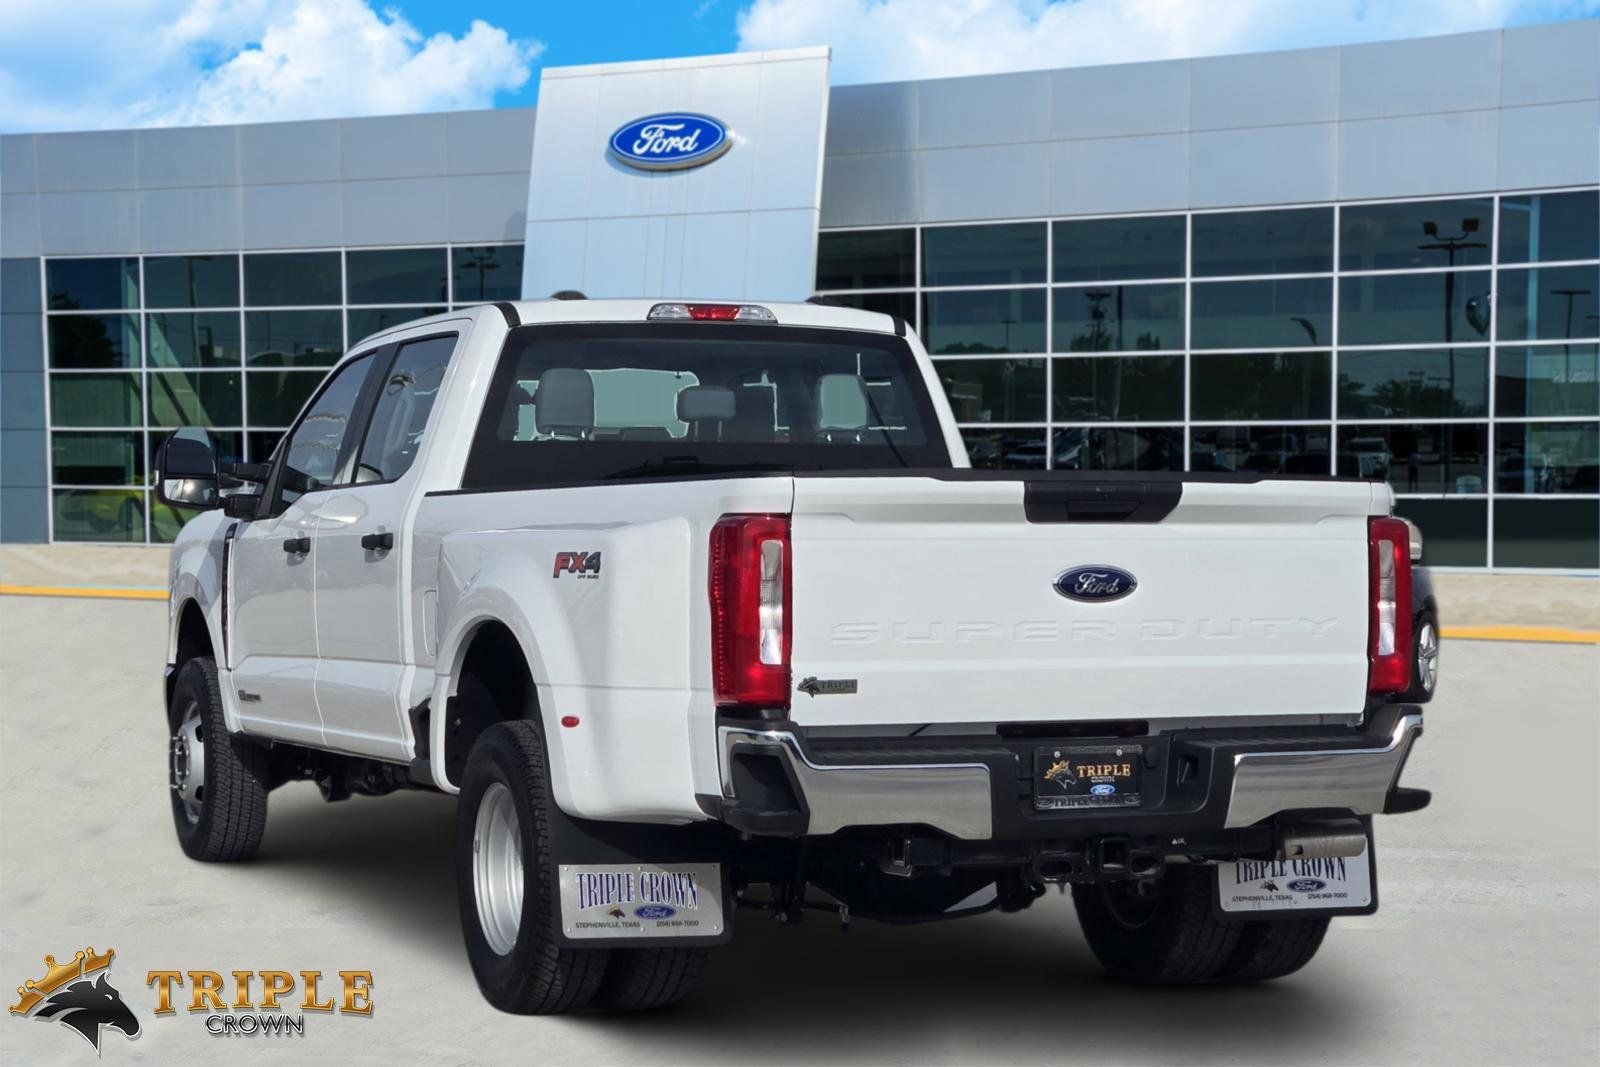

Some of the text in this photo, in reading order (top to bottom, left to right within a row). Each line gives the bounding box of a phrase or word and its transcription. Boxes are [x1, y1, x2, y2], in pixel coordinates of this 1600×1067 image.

[633, 123, 701, 154] Ford
[552, 551, 601, 578] FX4
[1074, 572, 1119, 593] Ford
[831, 616, 1340, 645] SUPER DUTY
[1076, 764, 1131, 778] TRIPLE
[576, 872, 699, 910] TRIPLE CROWN
[641, 906, 668, 918] Ford
